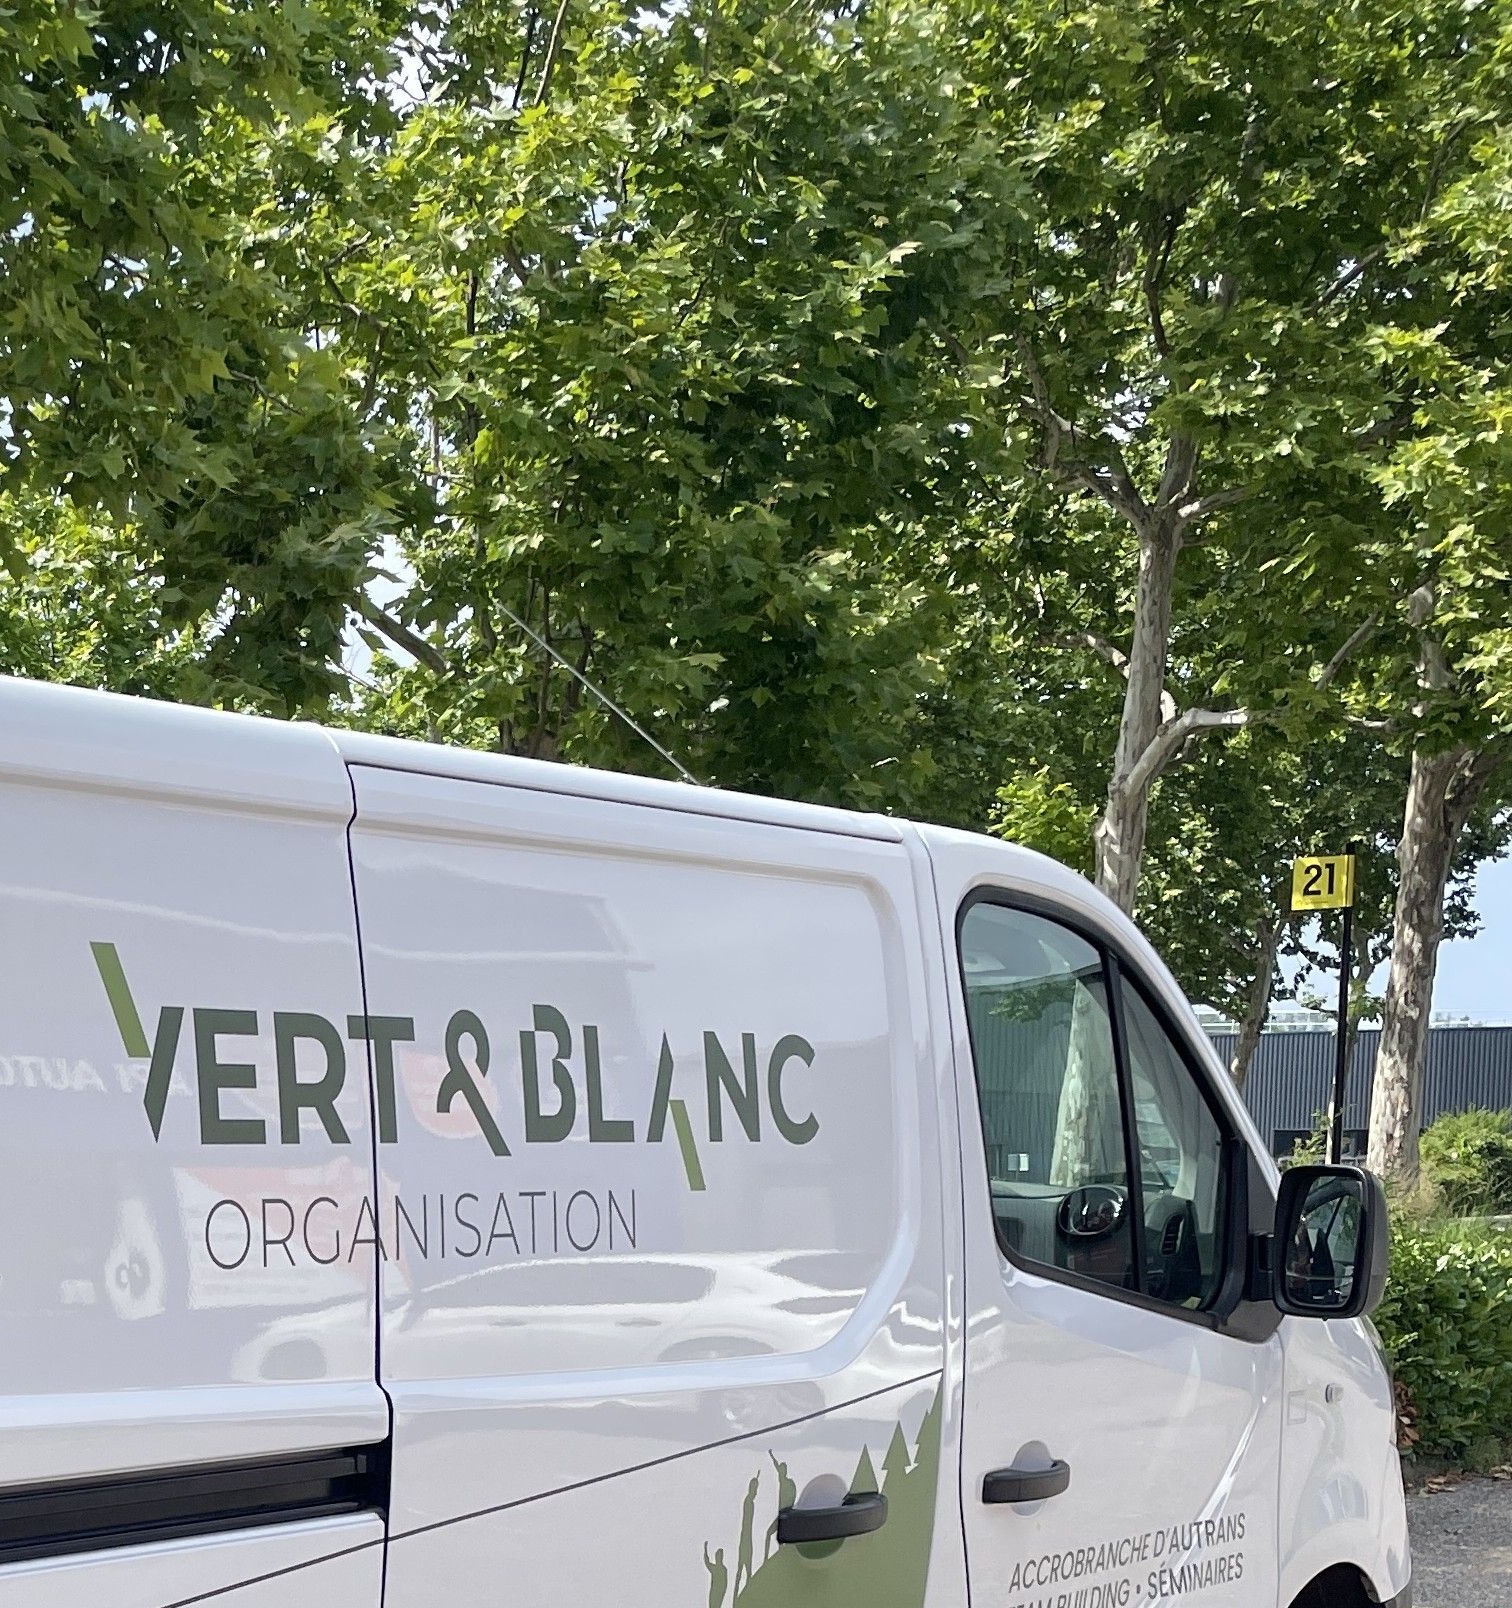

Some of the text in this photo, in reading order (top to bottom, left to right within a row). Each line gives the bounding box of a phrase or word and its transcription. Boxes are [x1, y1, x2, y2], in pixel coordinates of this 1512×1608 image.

[1302, 862, 1336, 896] 21
[90, 942, 821, 1191] VERT & BLANC
[203, 1188, 639, 1270] ORGANISATION
[1008, 1512, 1246, 1594] ACCROBRANCHE D'AUTRANS
[1147, 1552, 1244, 1601] SÉMINAIRES
